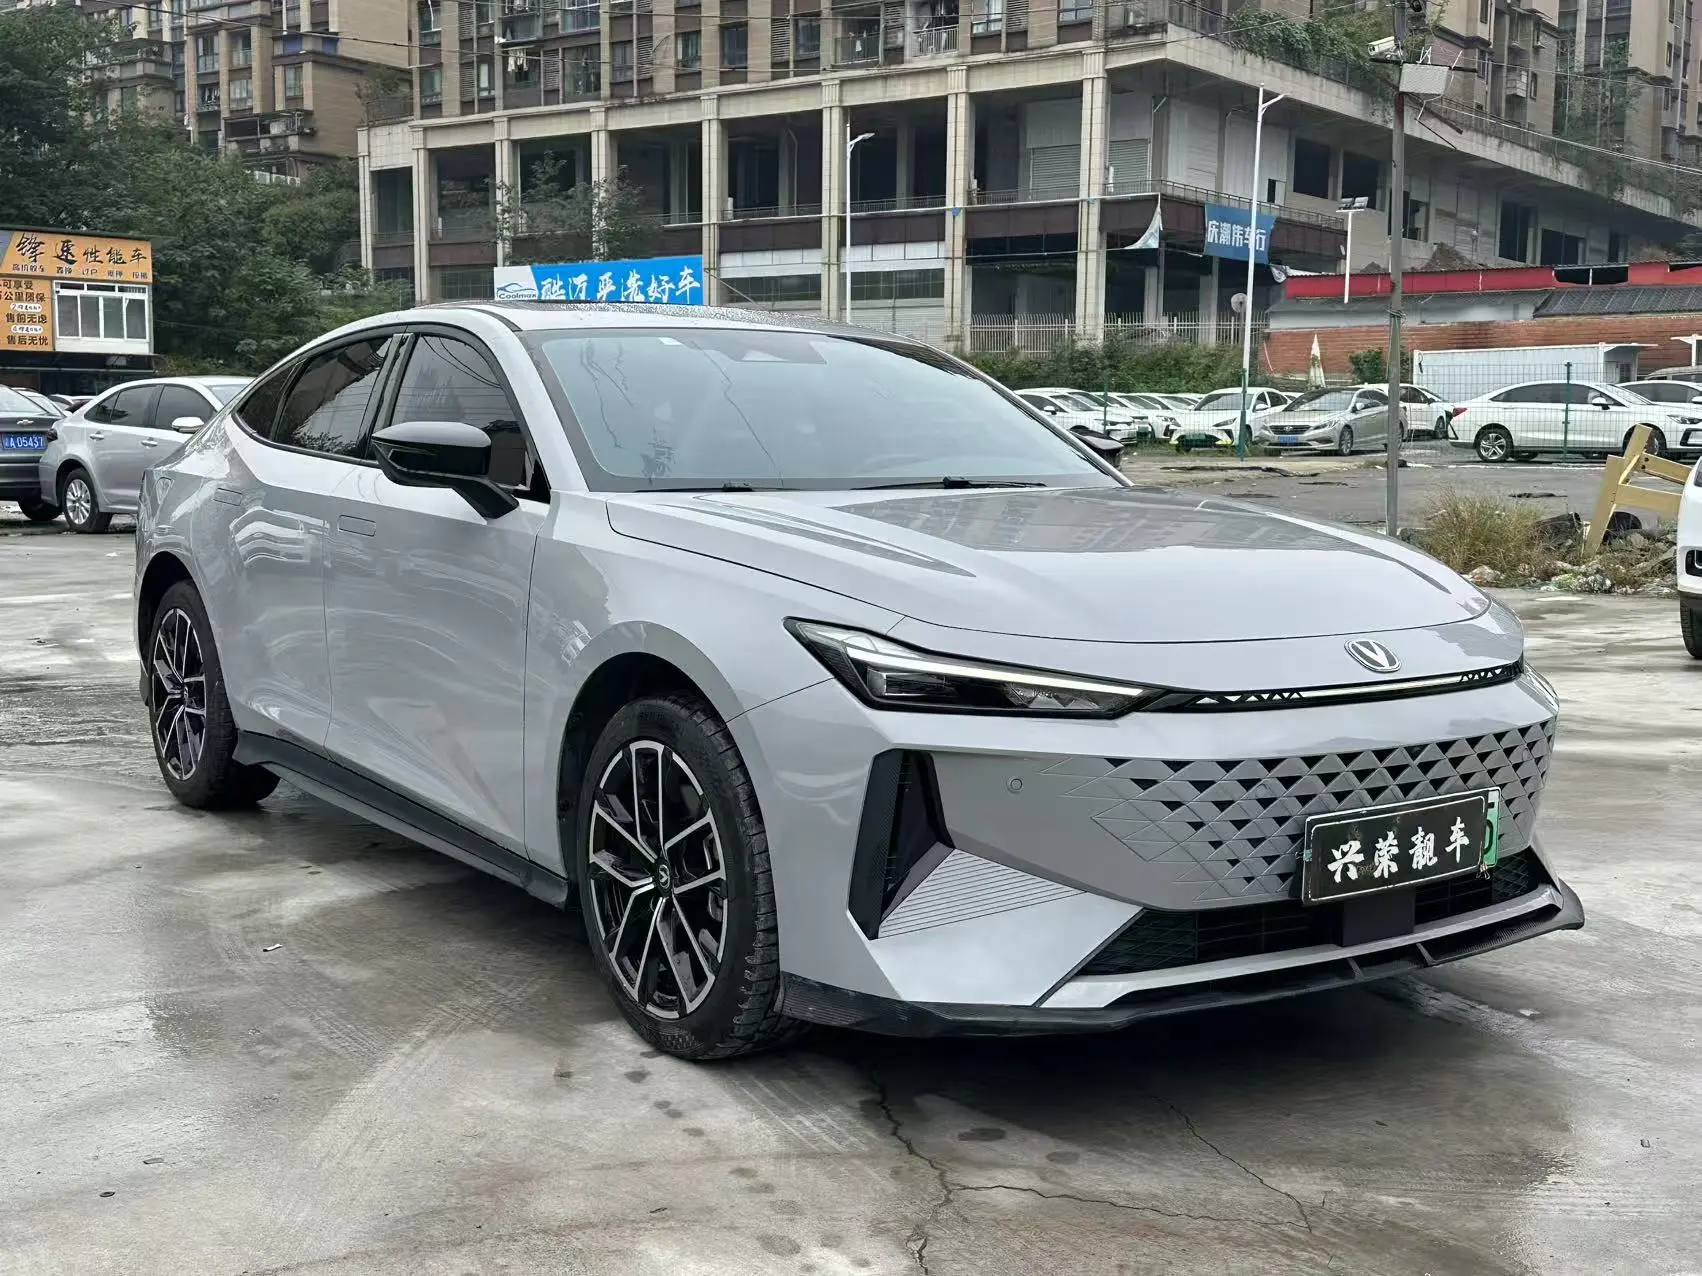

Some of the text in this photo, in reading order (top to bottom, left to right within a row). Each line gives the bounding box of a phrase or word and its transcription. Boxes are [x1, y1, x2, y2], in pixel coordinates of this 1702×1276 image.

[7, 335, 48, 346] 售后无忧
[1328, 816, 1470, 883] 兴荣靓车
